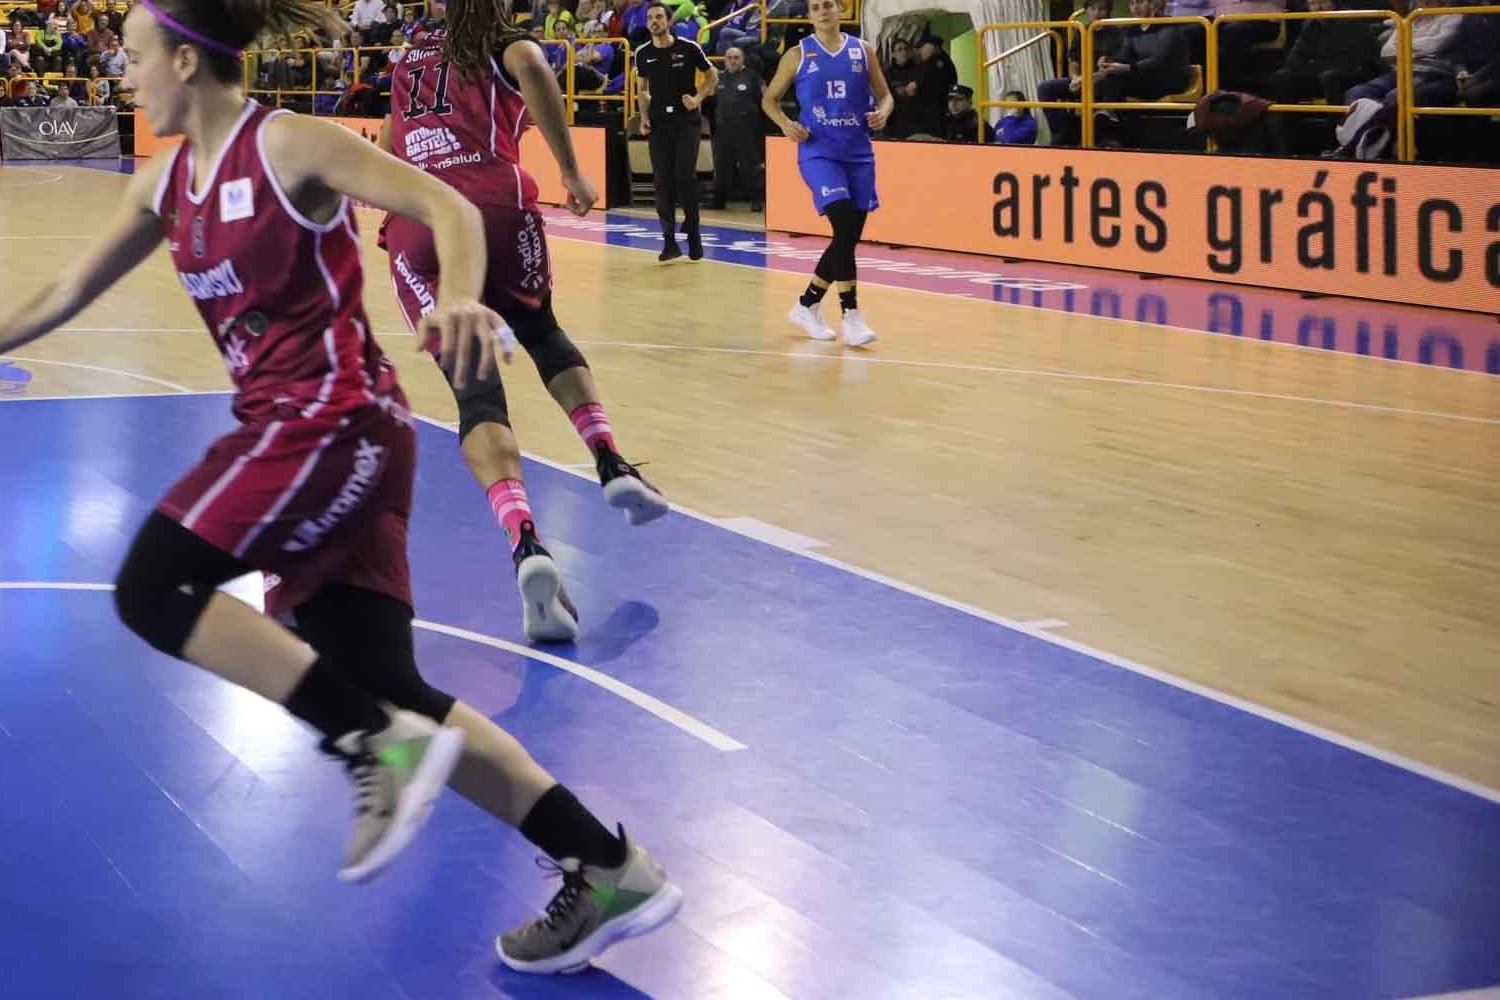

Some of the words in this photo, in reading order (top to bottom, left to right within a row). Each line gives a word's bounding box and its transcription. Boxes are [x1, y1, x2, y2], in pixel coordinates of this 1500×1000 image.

[404, 62, 453, 121] 11
[826, 80, 846, 99] 13
[992, 165, 1168, 252] artes
